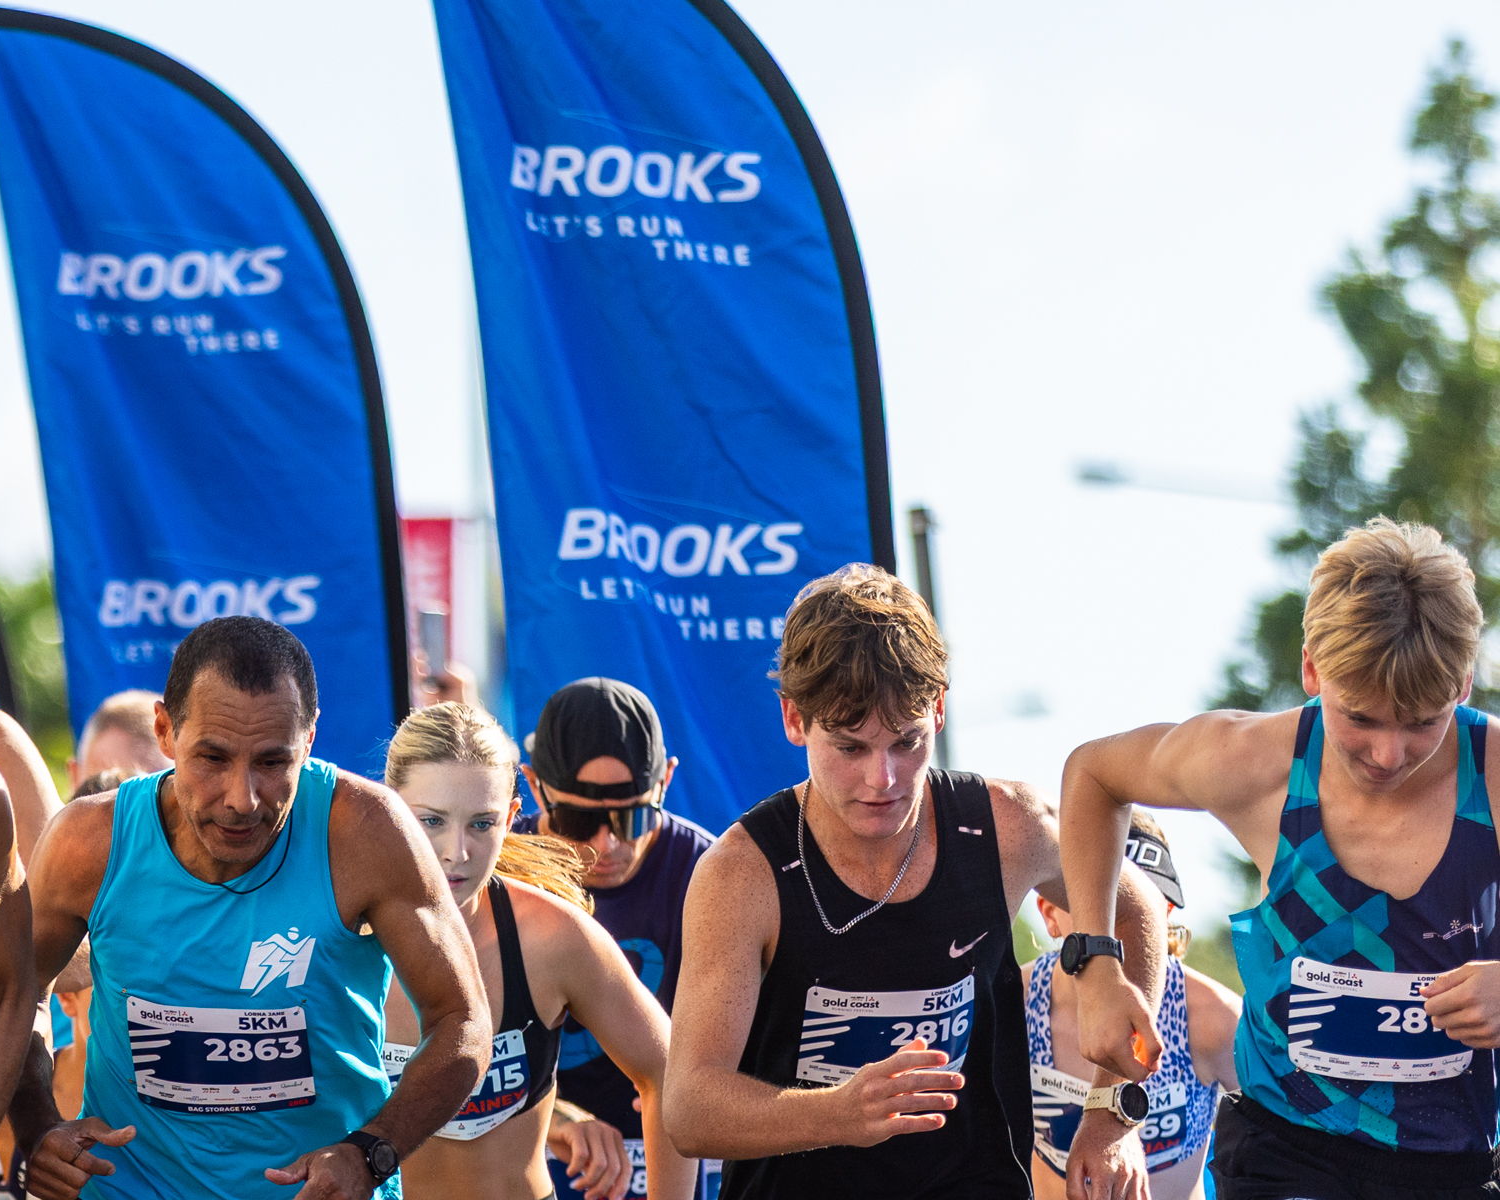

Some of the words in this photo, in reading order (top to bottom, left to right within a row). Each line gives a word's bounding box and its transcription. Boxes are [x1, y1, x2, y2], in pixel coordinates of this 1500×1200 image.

[510, 145, 762, 203] BROOKS
[616, 215, 685, 238] RUN
[652, 239, 751, 267] THERE
[57, 245, 288, 302] BROOKS
[558, 507, 804, 578] BROOKS
[99, 574, 321, 628] BROOKS
[931, 989, 951, 997] LORNA
[951, 982, 963, 993] JANE
[1306, 971, 1330, 983] gold
[1332, 976, 1363, 988] coast
[822, 998, 848, 1009] gold
[850, 1000, 880, 1009] coast
[922, 988, 963, 1012] 5KM
[140, 1009, 162, 1021] gold
[164, 1014, 194, 1024] coast
[238, 1016, 288, 1031] 5KM
[890, 1009, 969, 1046] 2816
[203, 1036, 302, 1062] 2863
[1041, 1077, 1062, 1089] gold
[1138, 1113, 1181, 1140] 69
